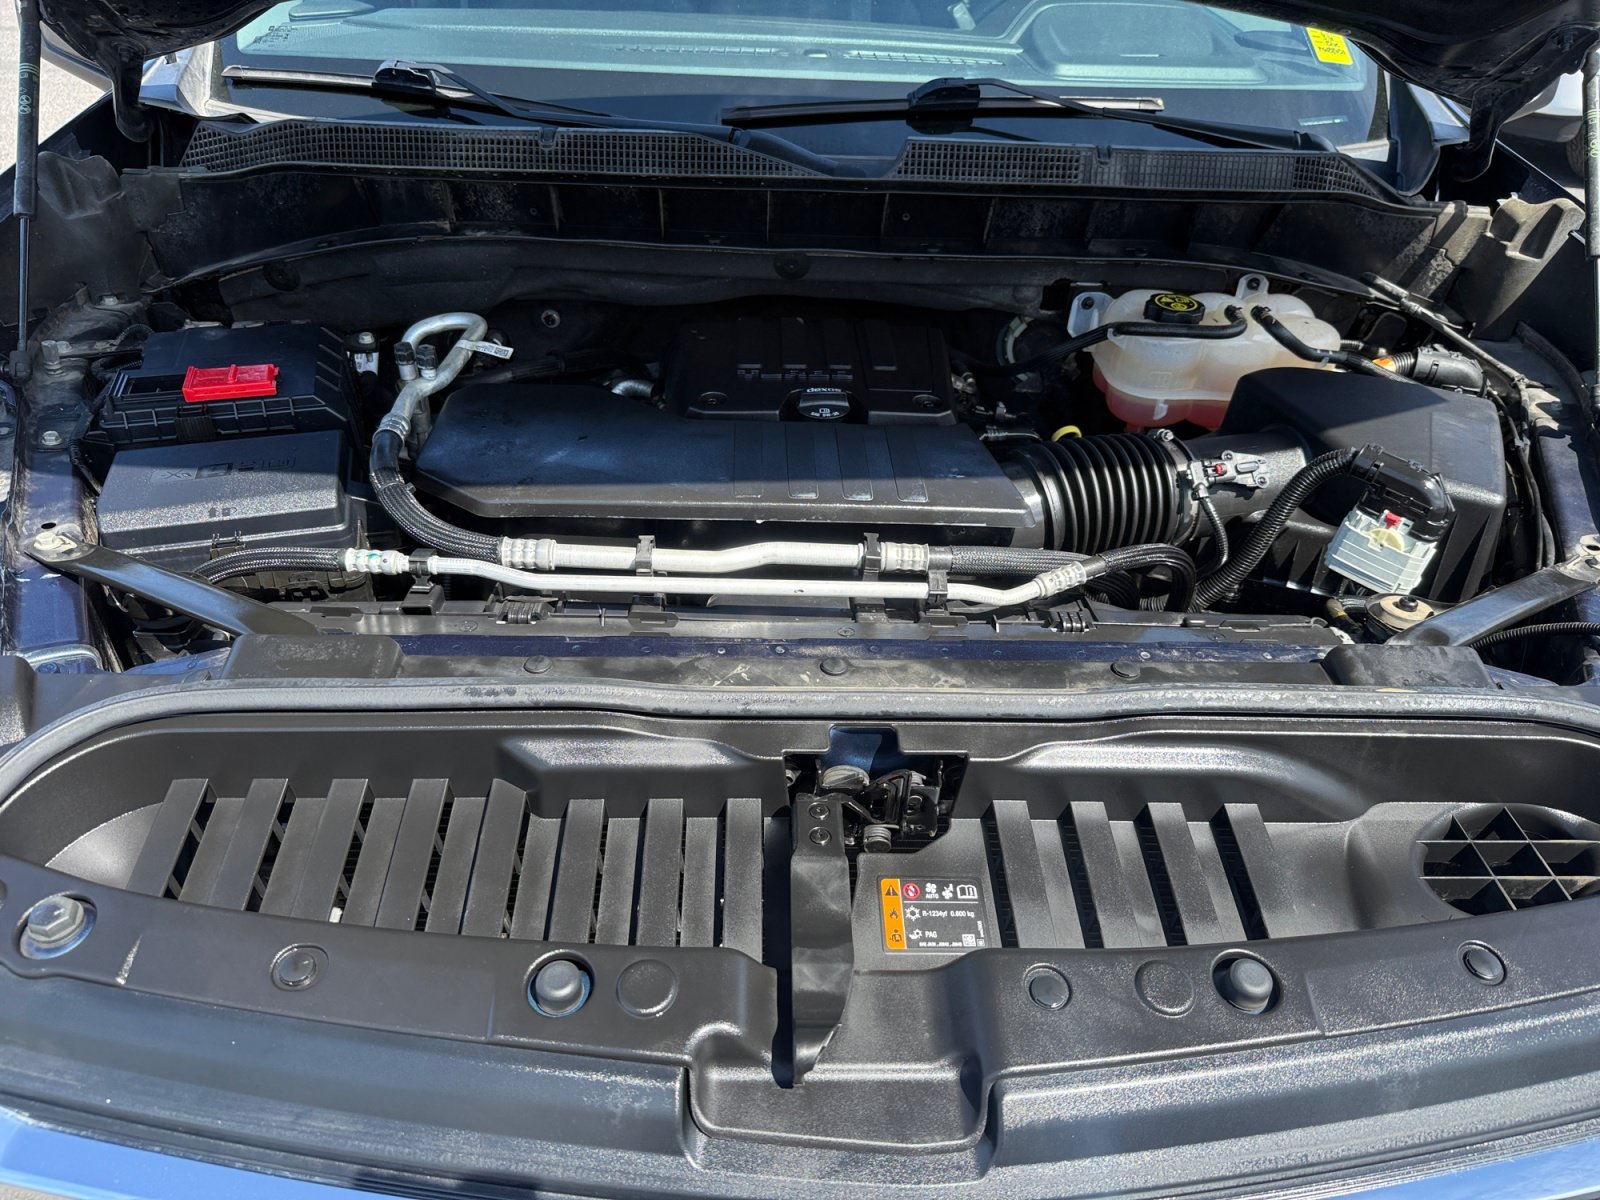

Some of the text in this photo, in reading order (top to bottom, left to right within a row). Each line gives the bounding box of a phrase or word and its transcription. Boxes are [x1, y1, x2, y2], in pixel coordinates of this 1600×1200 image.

[922, 910, 948, 918] R-1234yf
[966, 910, 975, 918] kg
[925, 930, 938, 938] PAG
